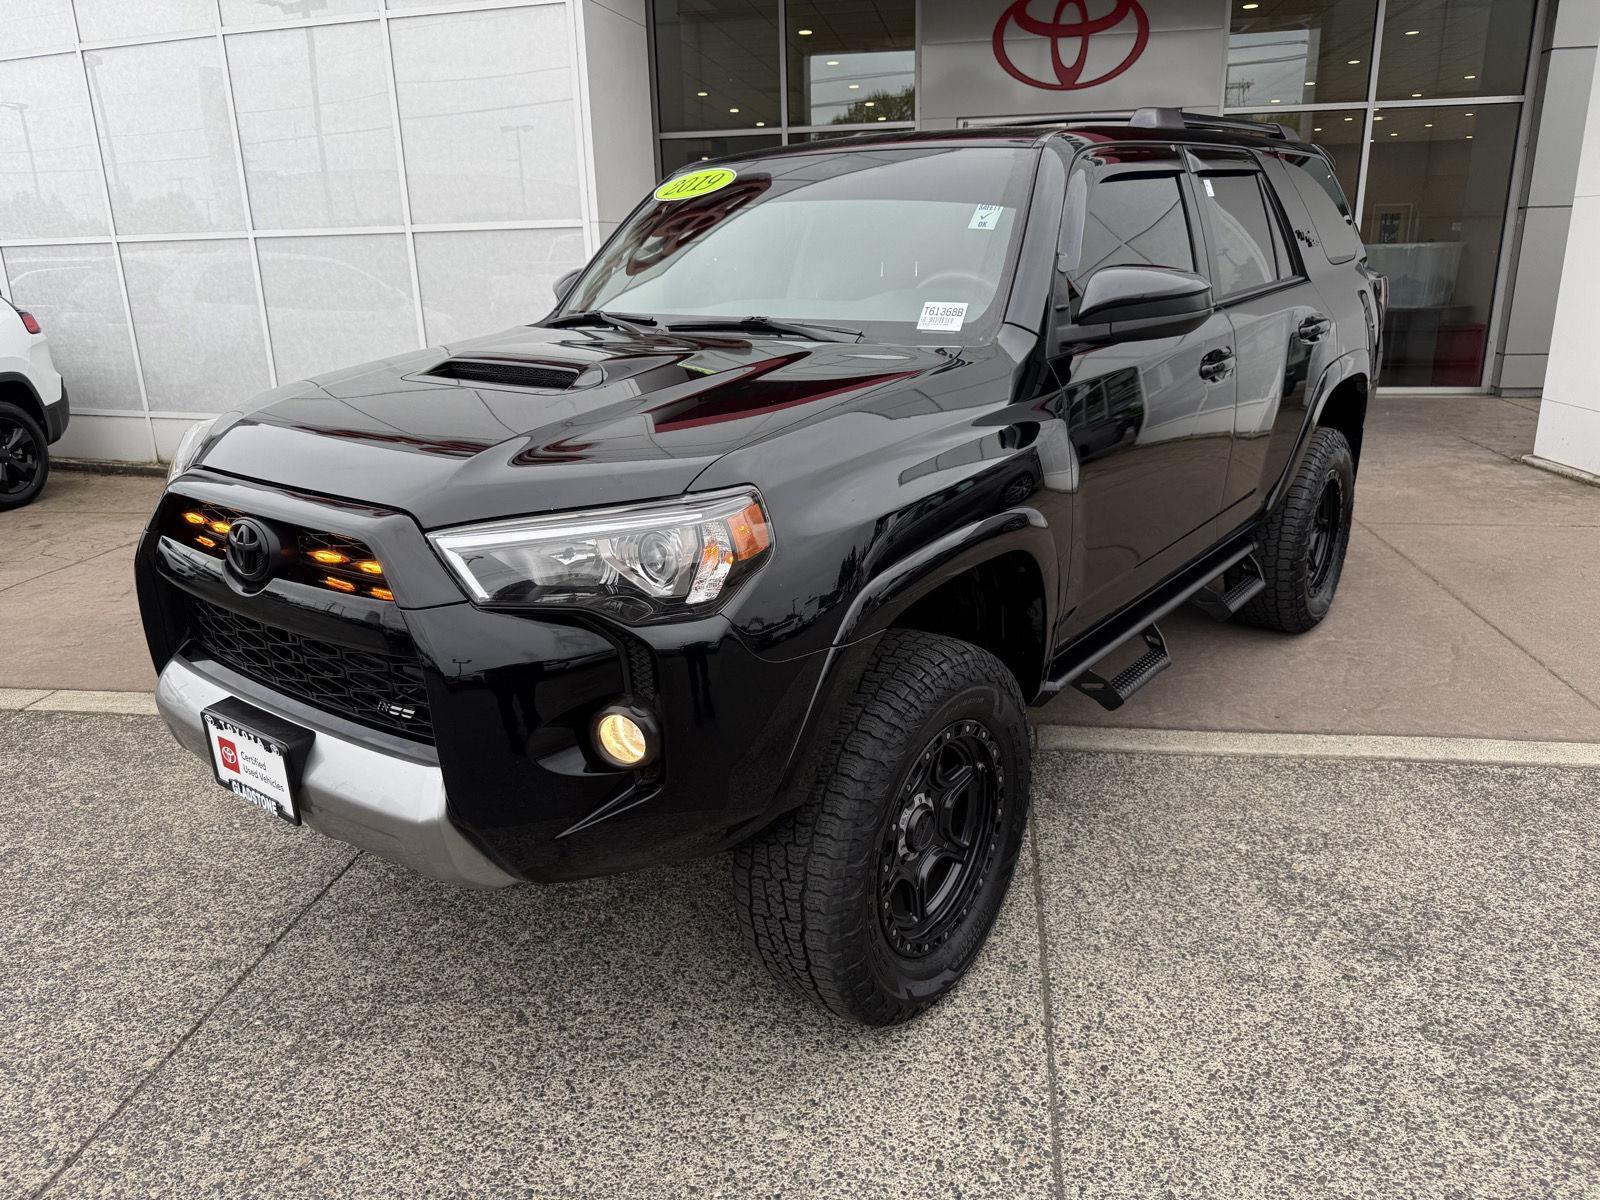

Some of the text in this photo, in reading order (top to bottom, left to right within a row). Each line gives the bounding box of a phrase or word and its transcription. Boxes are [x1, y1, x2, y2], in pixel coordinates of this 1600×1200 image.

[662, 173, 725, 197] 2019
[924, 306, 964, 317] T61368B
[219, 720, 264, 747] TOYOTA
[240, 751, 267, 771] Certified
[242, 764, 285, 793] Used Vehicles
[231, 781, 279, 816] GLADSTONE
